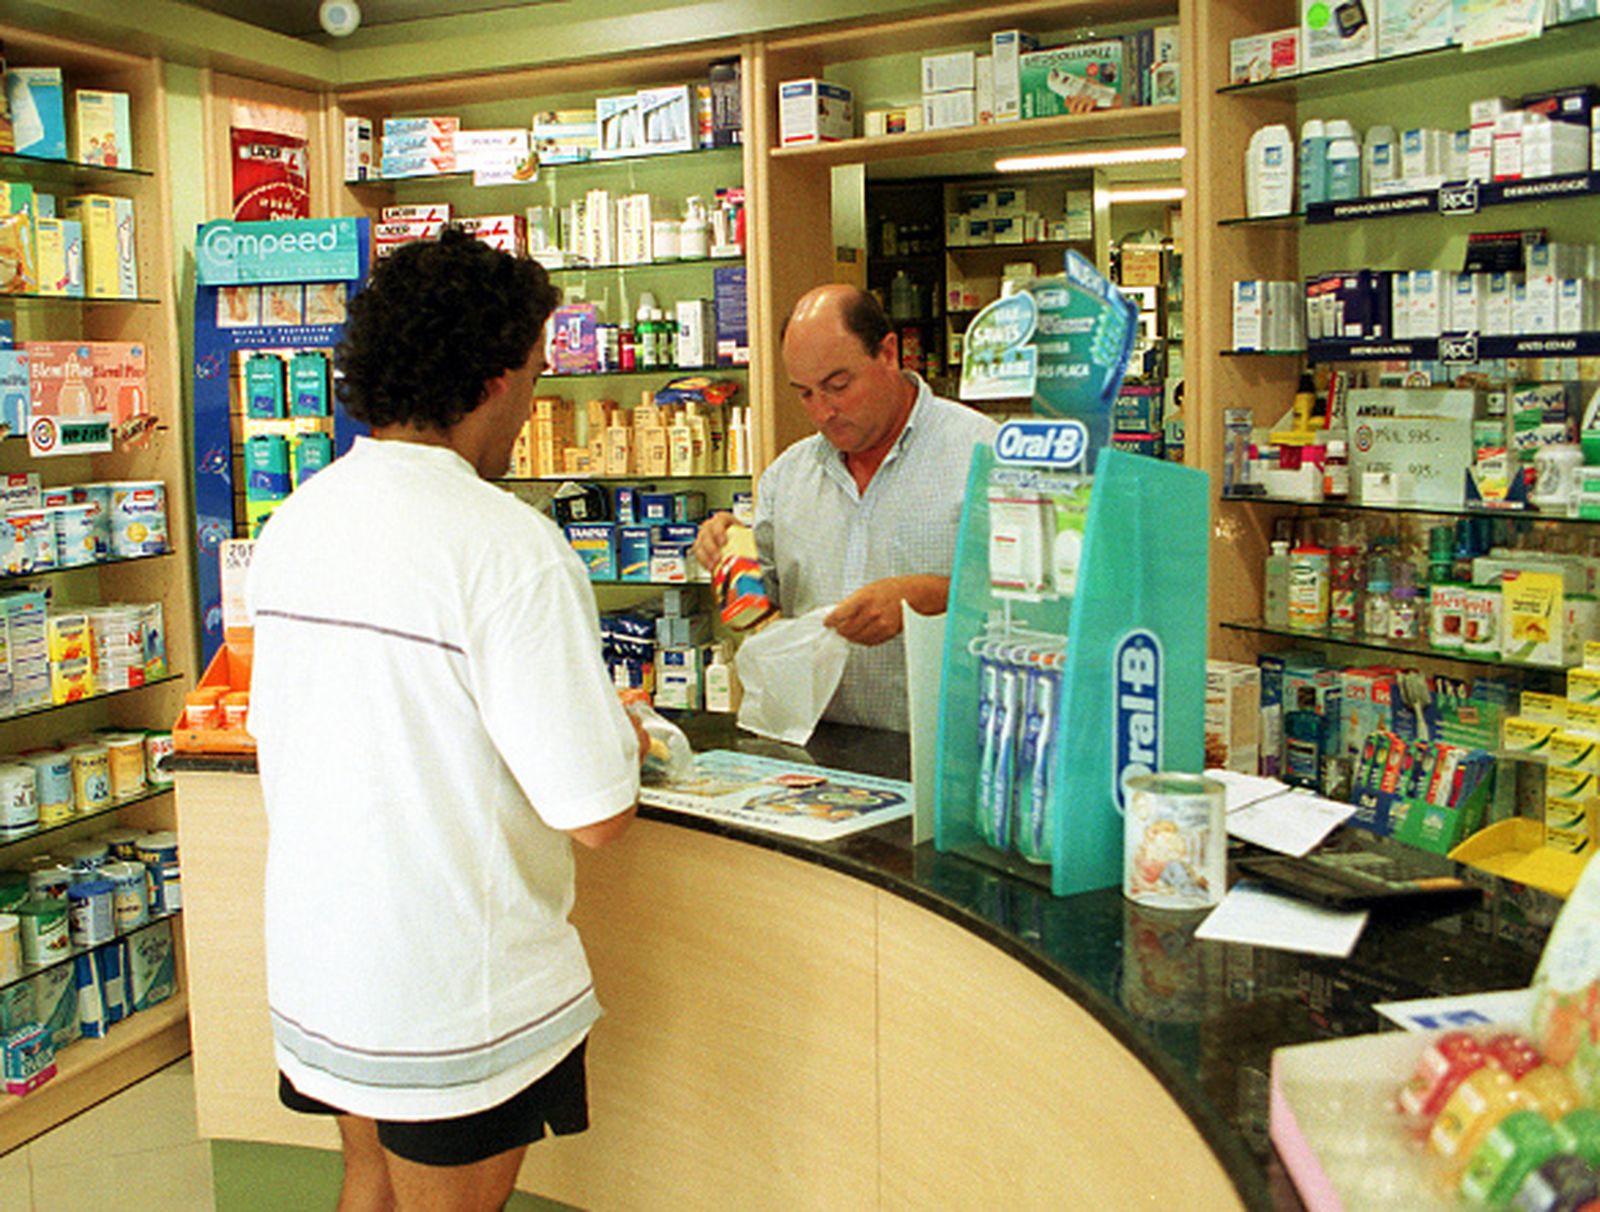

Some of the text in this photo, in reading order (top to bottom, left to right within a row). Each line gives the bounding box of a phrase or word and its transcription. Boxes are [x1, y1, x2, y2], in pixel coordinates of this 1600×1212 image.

[203, 222, 338, 265] Compeed
[1001, 428, 1079, 458] Oral-B
[569, 528, 610, 540] TAMPAX
